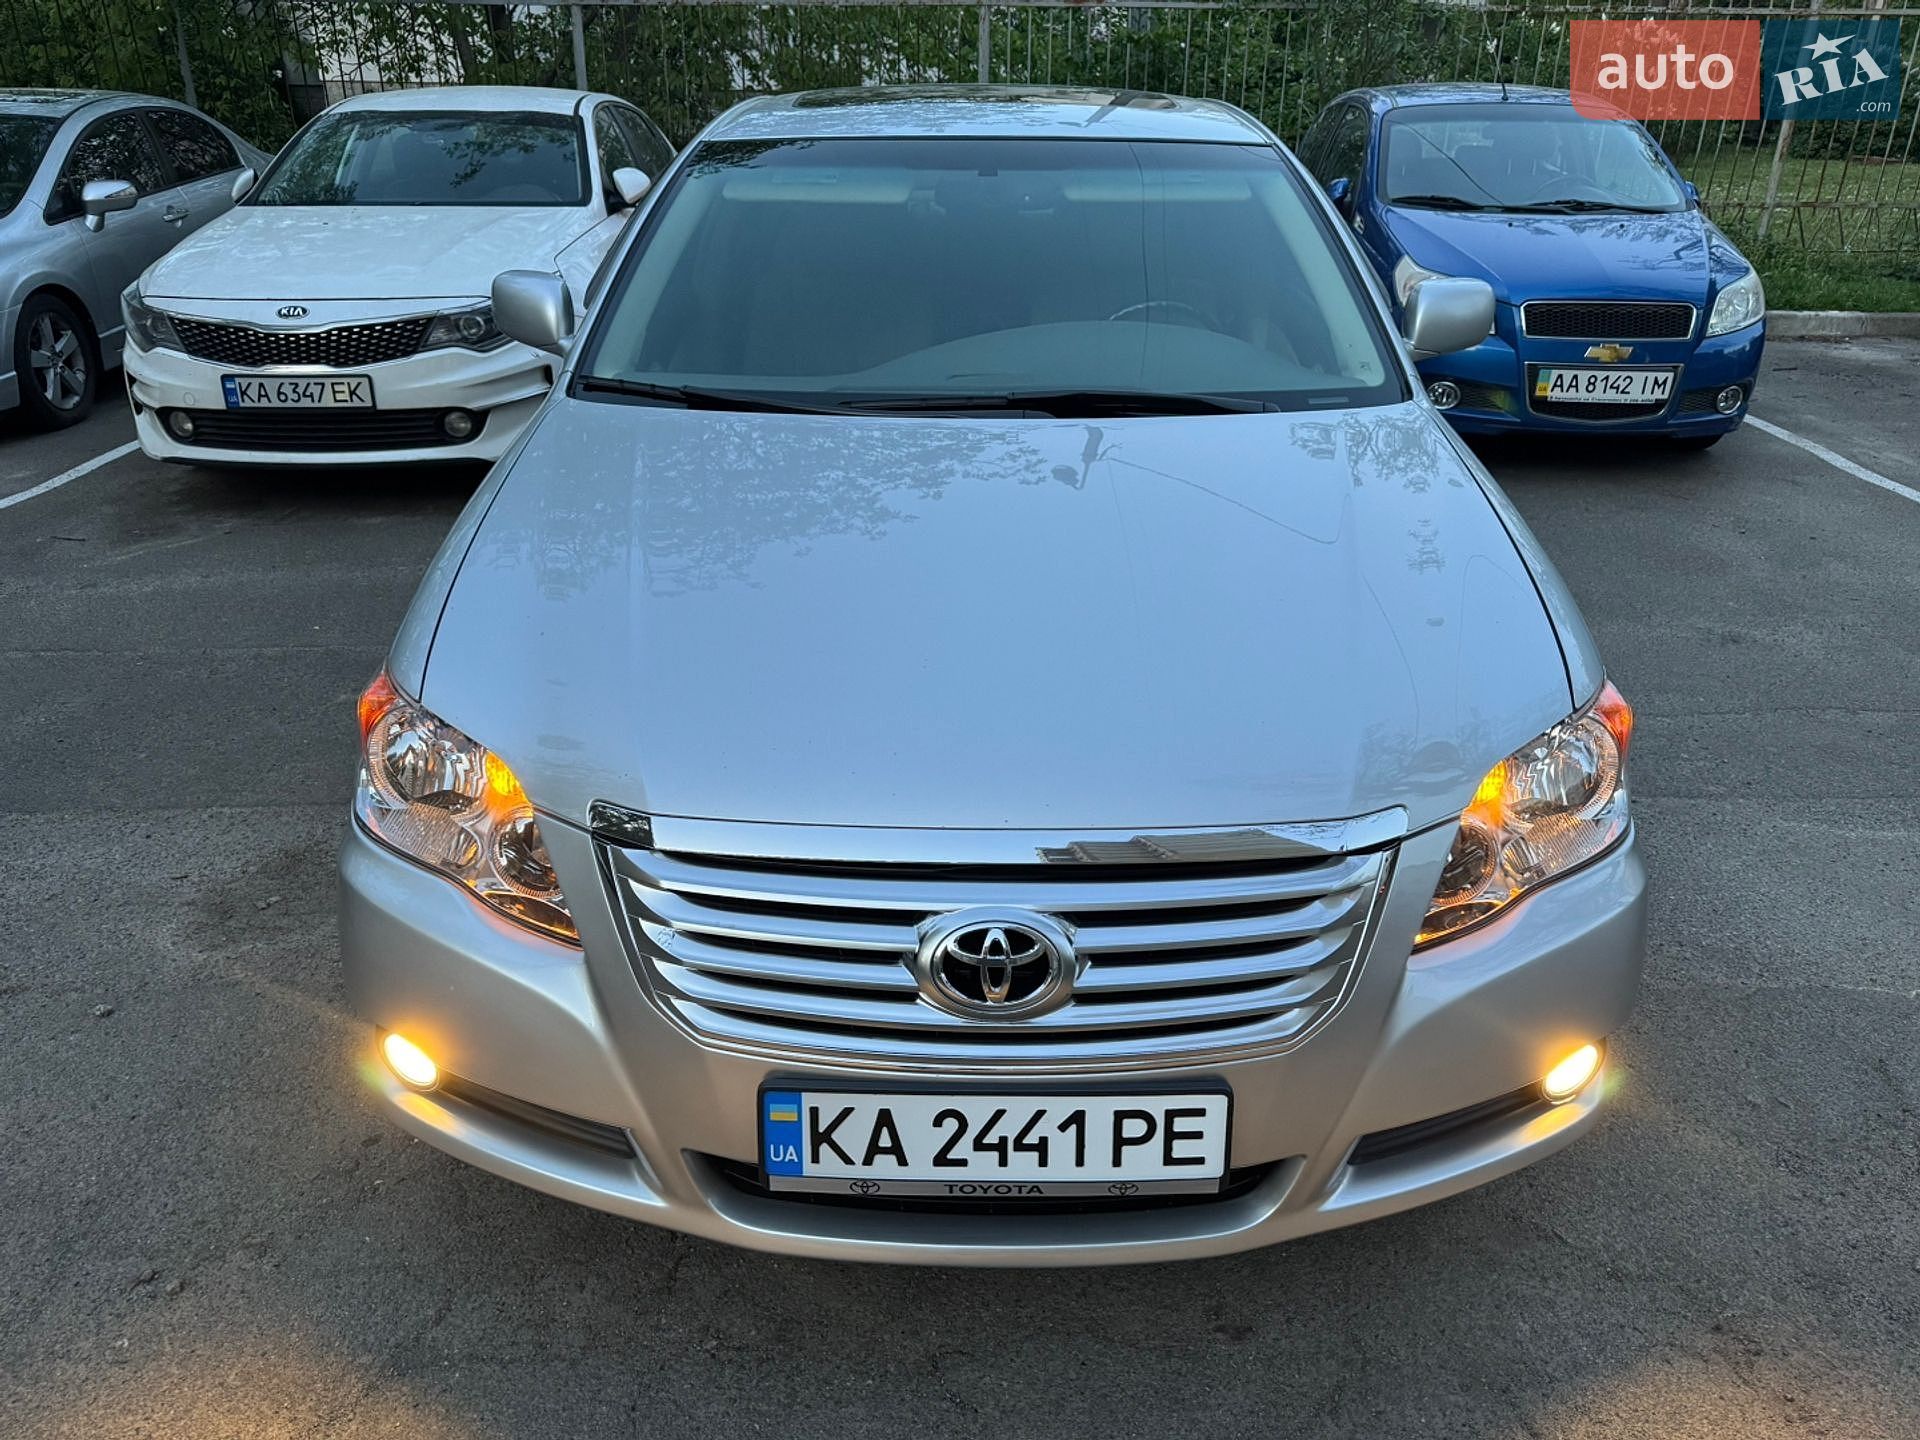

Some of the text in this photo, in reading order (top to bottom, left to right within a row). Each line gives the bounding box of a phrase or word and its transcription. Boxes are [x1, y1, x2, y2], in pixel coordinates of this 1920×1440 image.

[281, 307, 304, 316] KIA
[238, 382, 365, 403] KA 6347 EK
[1551, 374, 1669, 396] AA 8142 IM
[808, 1106, 1206, 1168] KA 2441 PE
[770, 1144, 799, 1163] UA
[943, 1183, 1044, 1196] TOYOTA
